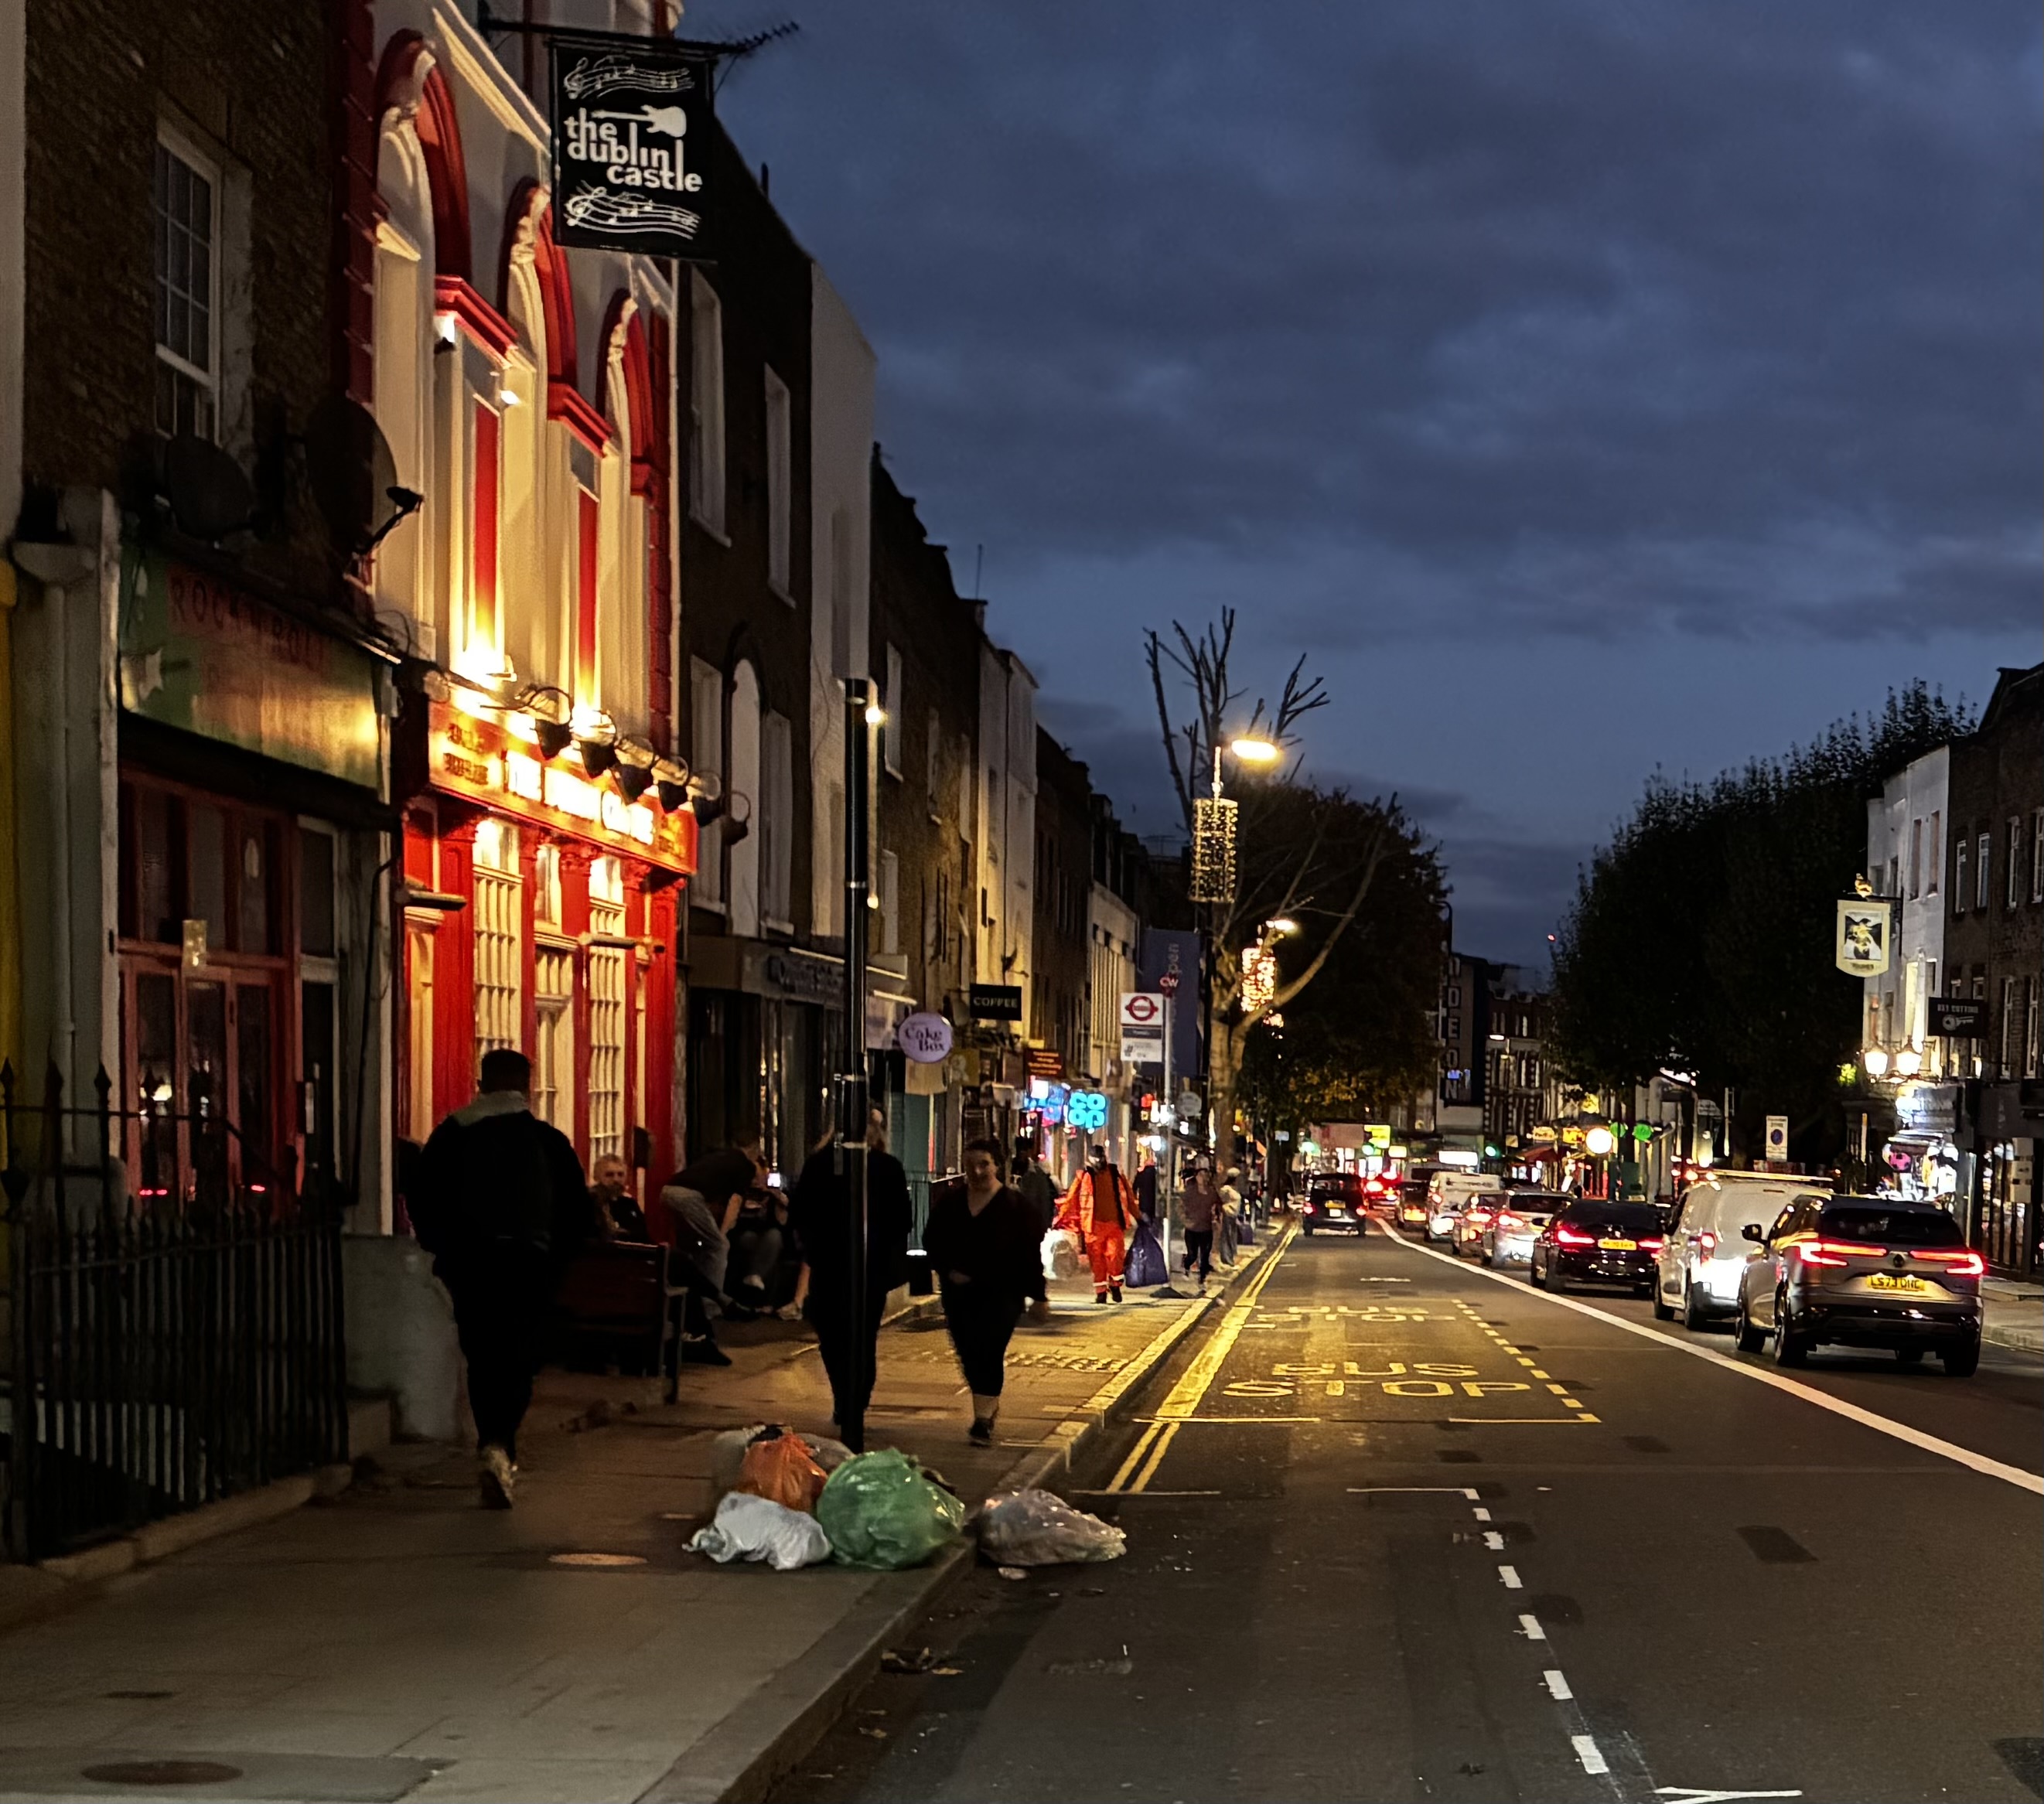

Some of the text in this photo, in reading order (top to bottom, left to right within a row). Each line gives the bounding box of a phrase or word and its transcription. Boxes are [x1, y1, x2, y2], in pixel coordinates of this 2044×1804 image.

[564, 107, 617, 142] the
[567, 122, 670, 167] dublin
[606, 139, 703, 192] castle
[973, 997, 1018, 1009] COFFEE
[905, 1028, 943, 1042] Cake
[1446, 957, 1461, 1100] ODEON
[919, 1040, 944, 1052] Box
[1272, 1362, 1479, 1376] BUS
[1222, 1379, 1531, 1397] STOP
